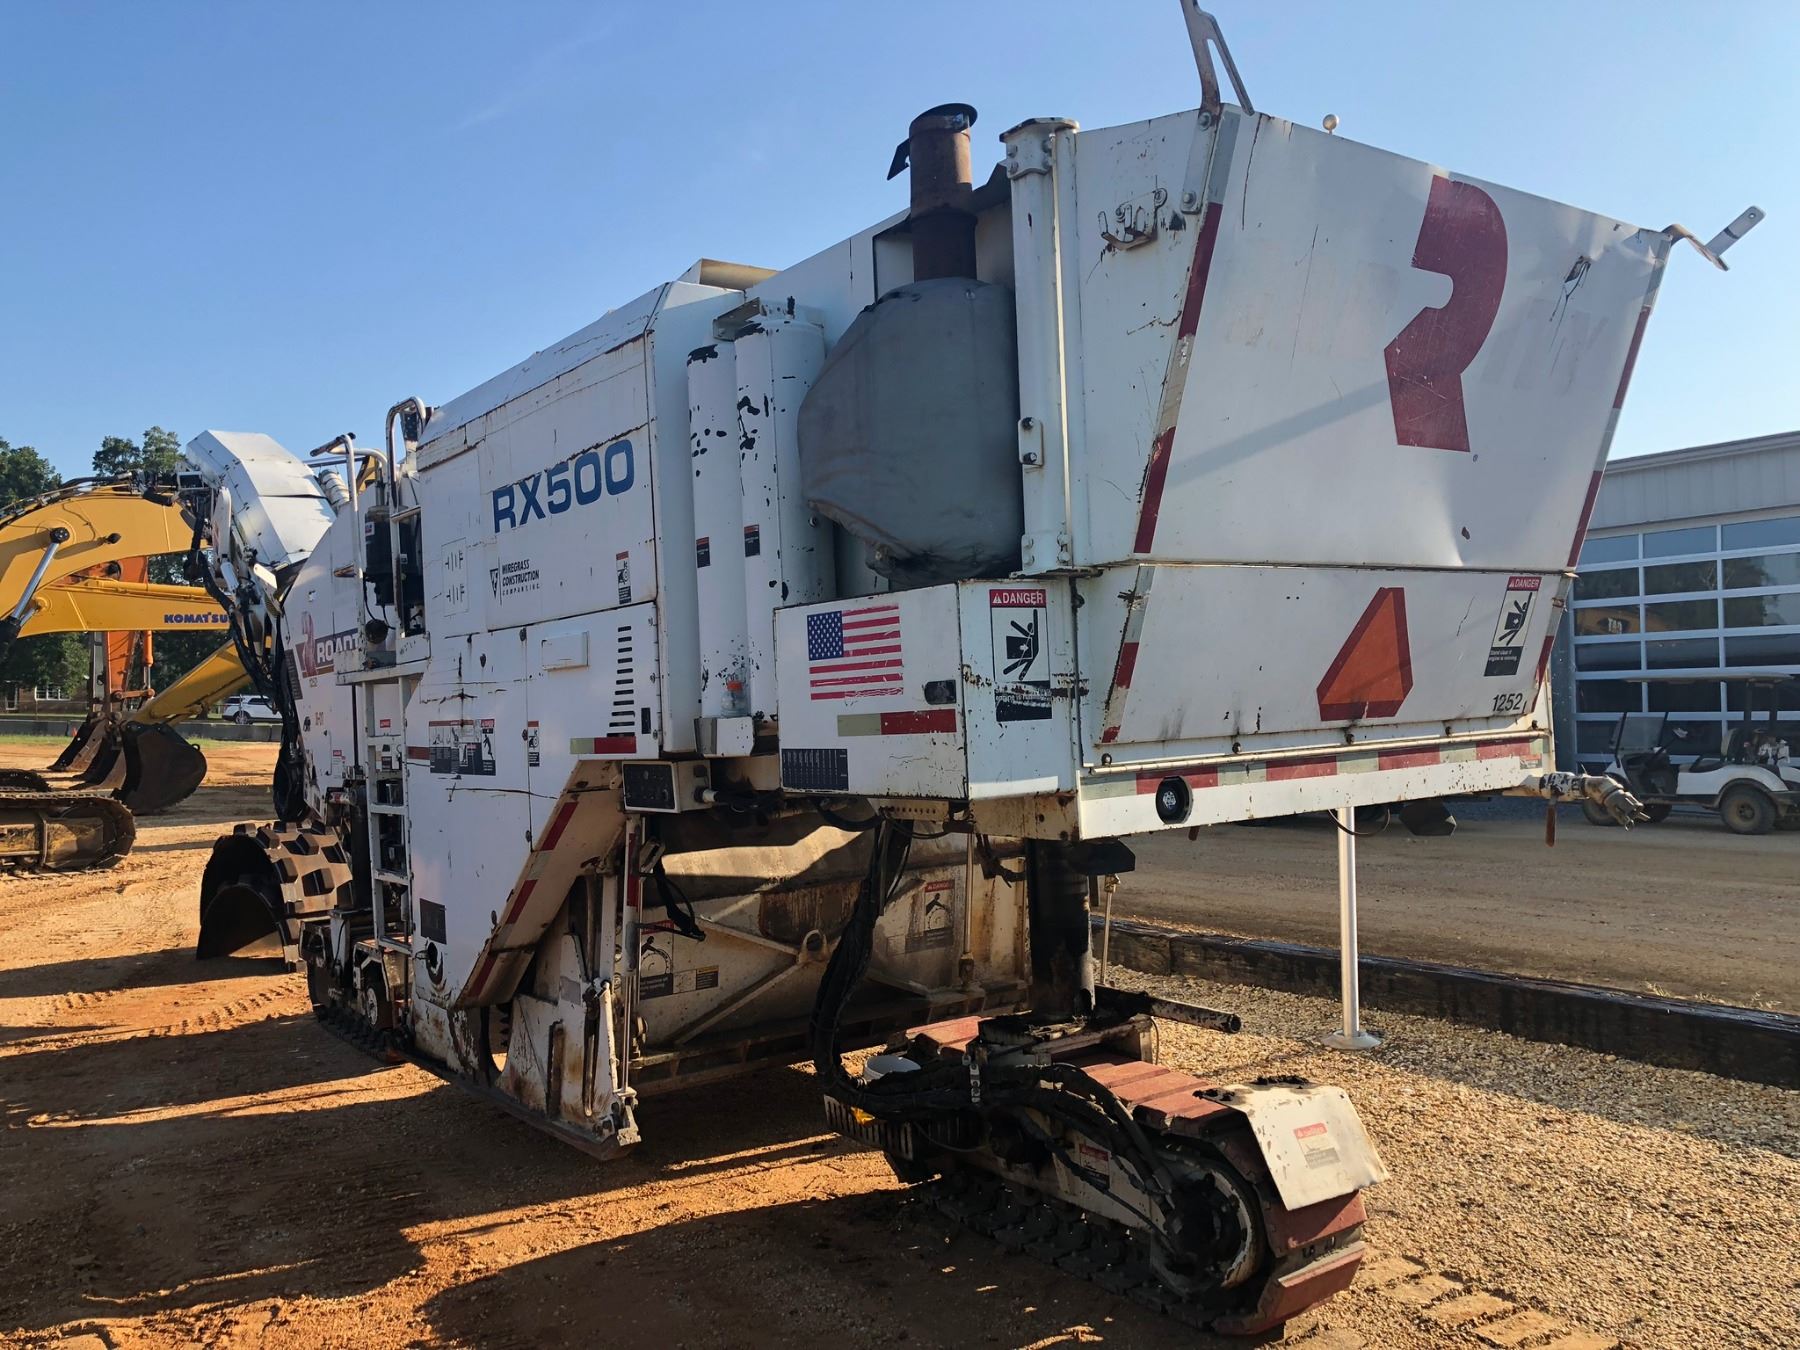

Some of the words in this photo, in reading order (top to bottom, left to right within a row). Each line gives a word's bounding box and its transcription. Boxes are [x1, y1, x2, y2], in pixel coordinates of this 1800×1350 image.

[493, 439, 635, 533] RX500
[502, 559, 530, 575] WIREGRASS
[502, 569, 540, 587] CONSTRUCTION
[1514, 579, 1540, 588] DANGER
[1002, 592, 1044, 604] DANGER
[164, 613, 228, 624] KOMATSU
[1492, 692, 1523, 712] 1252
